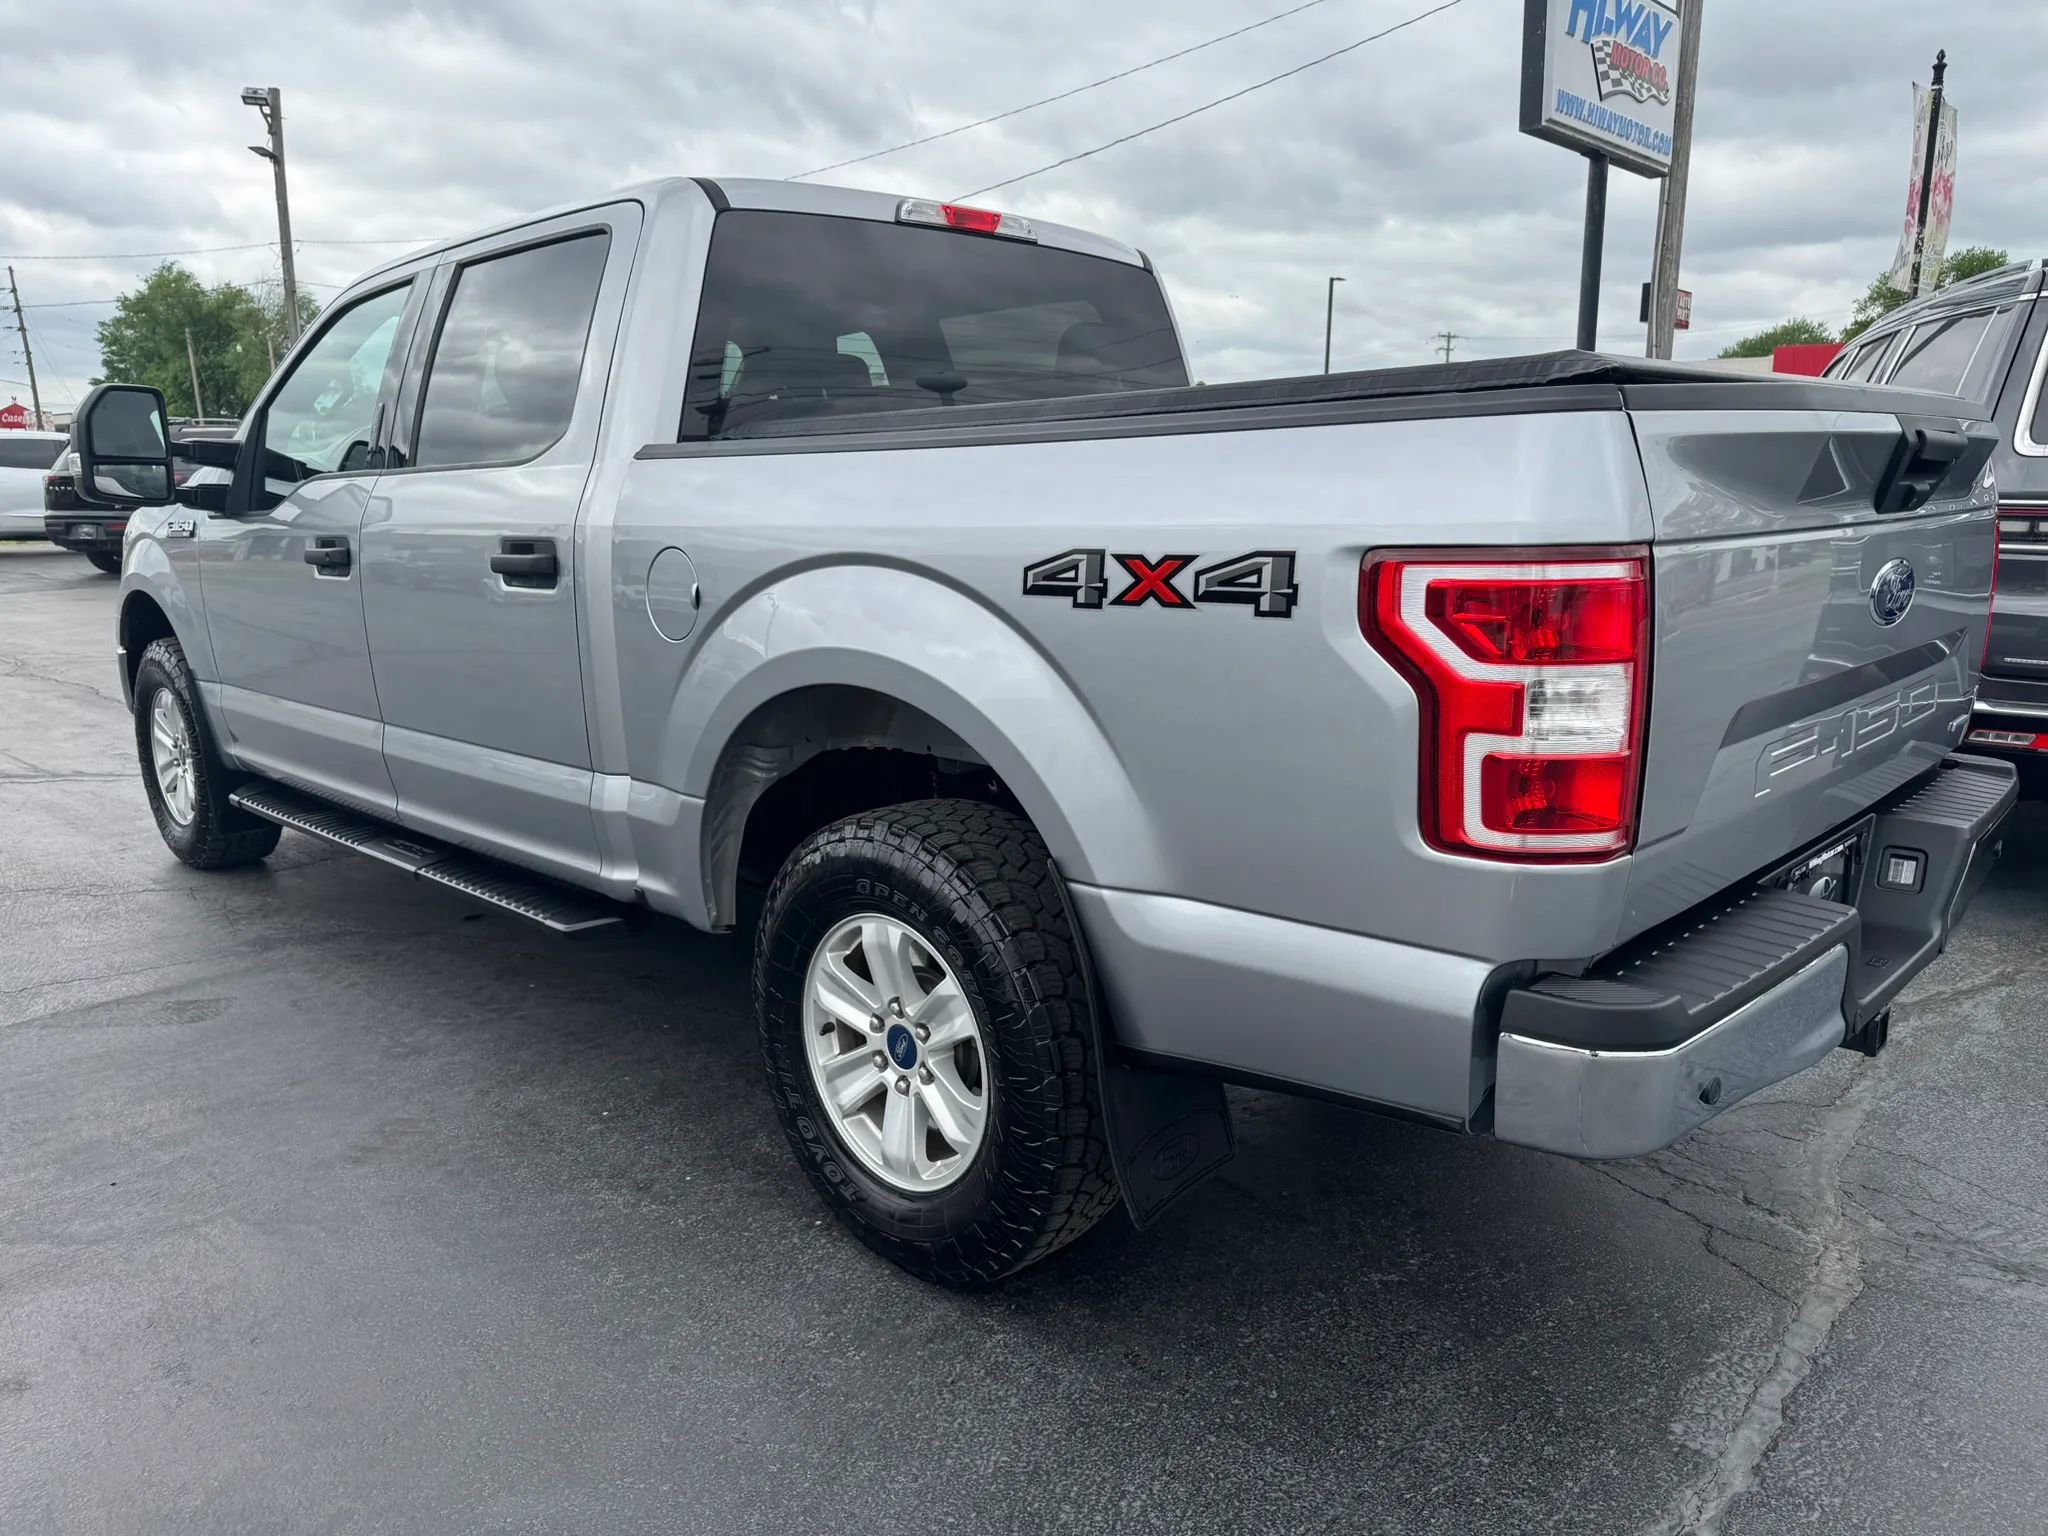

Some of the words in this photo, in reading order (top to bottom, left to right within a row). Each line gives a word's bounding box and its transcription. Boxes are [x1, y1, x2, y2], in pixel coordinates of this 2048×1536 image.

[1611, 40, 1652, 79] MOTOR
[1556, 88, 1672, 156] WWW.HIWAYMOTOR.COM
[1754, 679, 1939, 798] F-150
[856, 878, 929, 922] OPEN
[796, 1116, 861, 1201] TOYO
